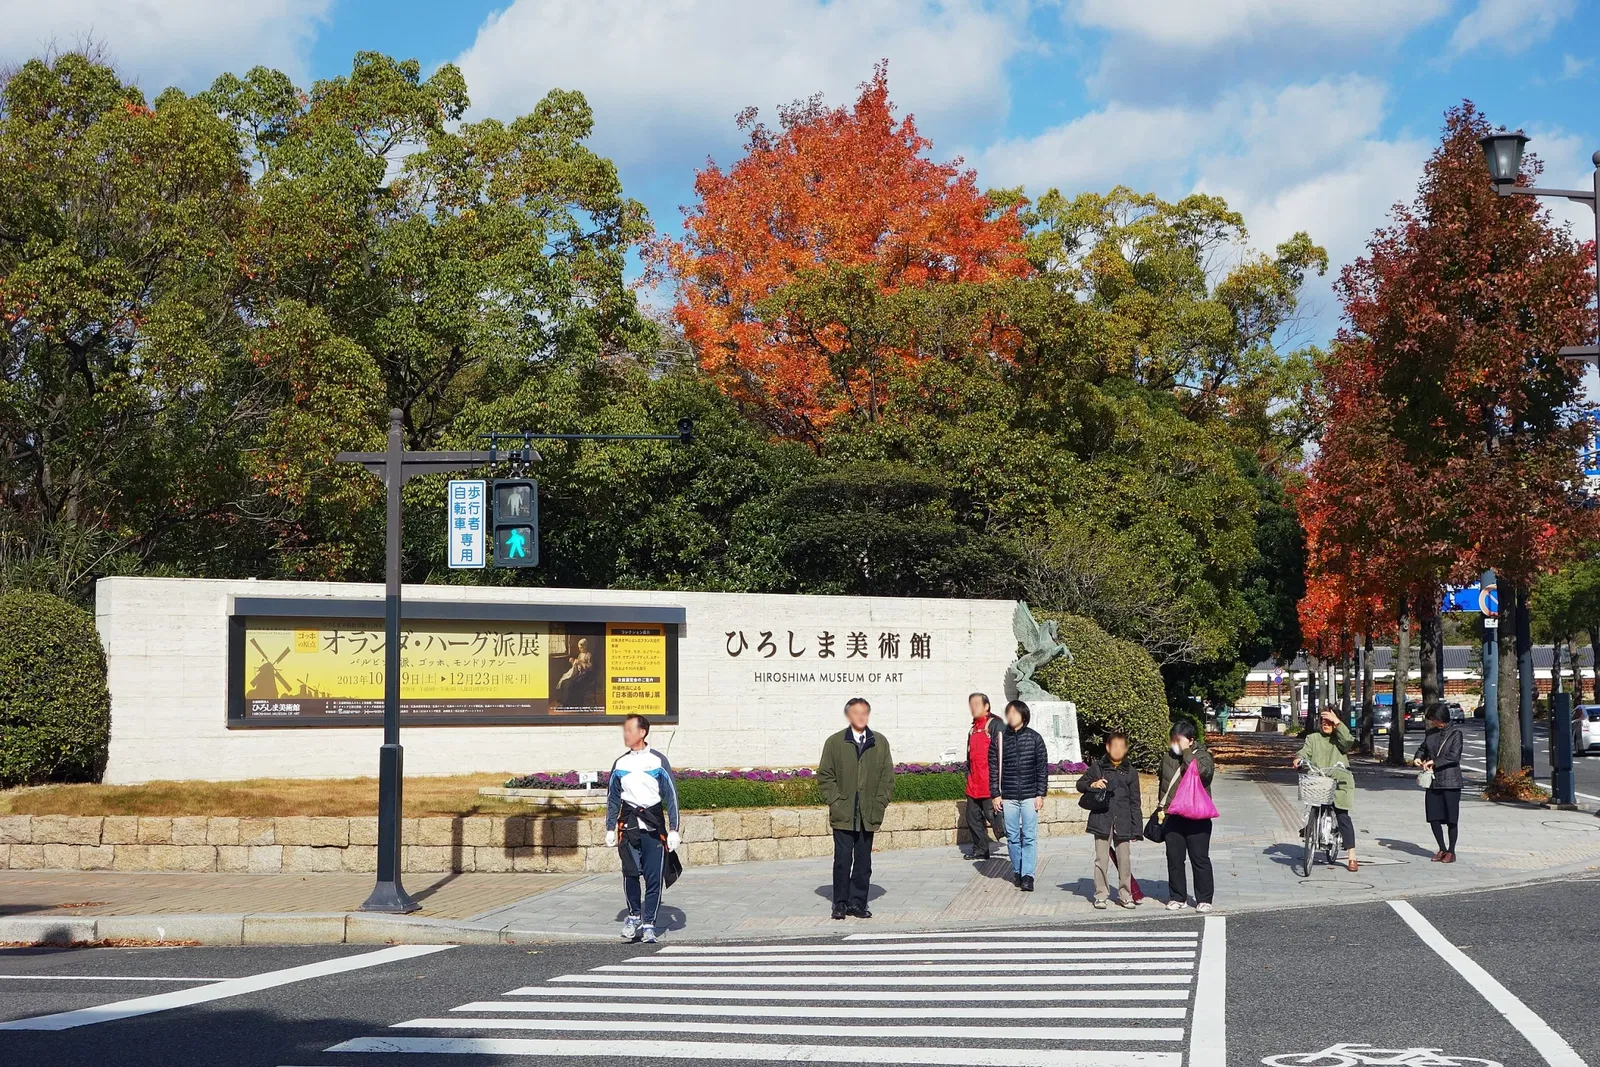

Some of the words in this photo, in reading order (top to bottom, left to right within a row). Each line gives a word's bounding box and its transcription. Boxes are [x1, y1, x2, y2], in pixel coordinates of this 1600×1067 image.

[454, 486, 466, 531] 自転車
[468, 486, 481, 531] 歩行者
[460, 533, 473, 562] 専用
[298, 632, 316, 640] ゴッホ
[725, 630, 932, 659] ひろしま美術館
[754, 671, 816, 683] HIROSHIMA
[819, 671, 865, 683] MUSEUM
[868, 672, 882, 683] OF
[885, 672, 904, 683] ART
[252, 703, 301, 712] ひろしま美術館
